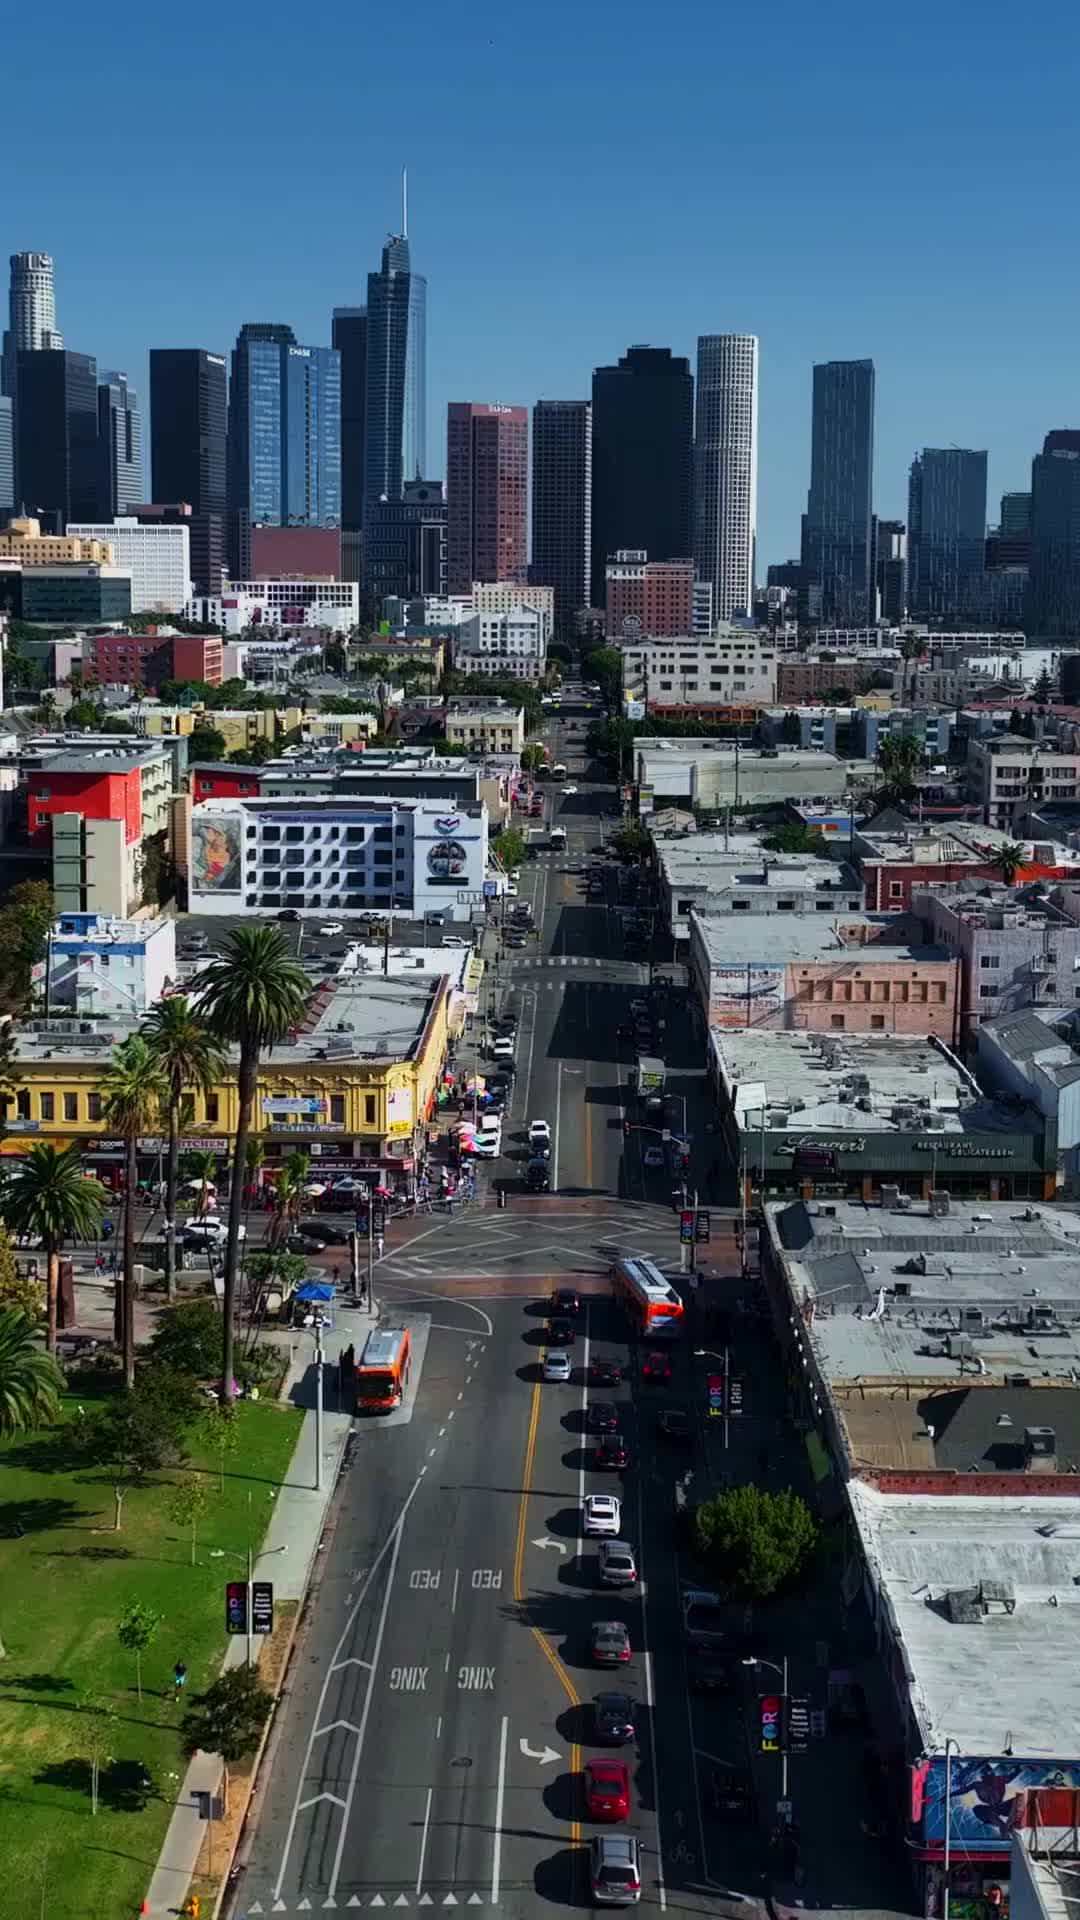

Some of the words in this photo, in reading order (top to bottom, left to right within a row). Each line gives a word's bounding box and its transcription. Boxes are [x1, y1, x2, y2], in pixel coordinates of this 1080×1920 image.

[409, 1569, 441, 1589] PED
[471, 1569, 503, 1589] PED
[389, 1666, 429, 1690] XING
[457, 1666, 496, 1690] XING
